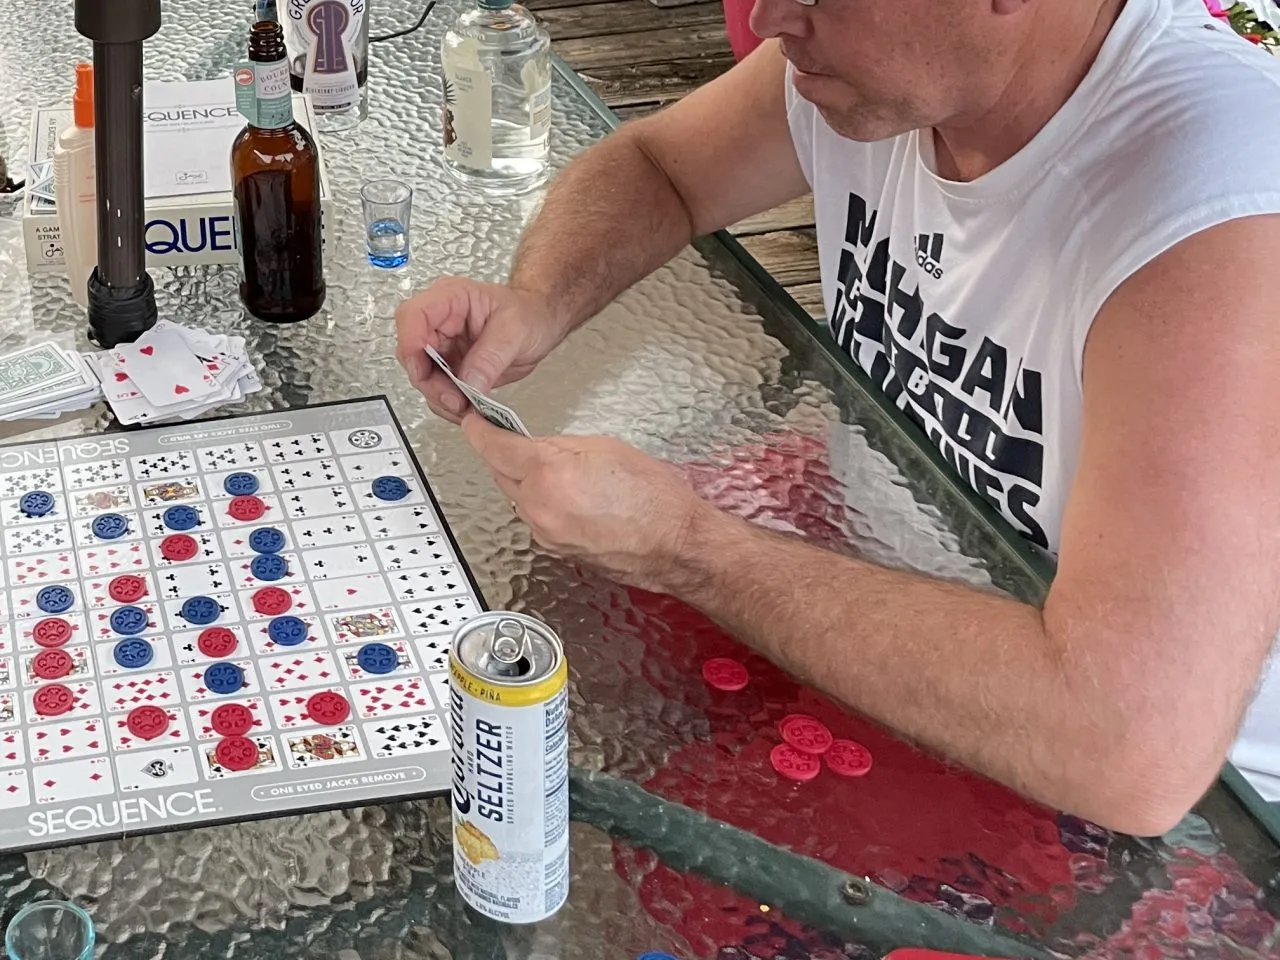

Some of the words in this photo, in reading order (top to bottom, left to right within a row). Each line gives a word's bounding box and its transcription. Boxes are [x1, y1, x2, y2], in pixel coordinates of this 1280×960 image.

[144, 107, 239, 122] QUENCE
[918, 254, 944, 280] das
[844, 191, 1043, 435] MCHGAN
[480, 688, 502, 702] PIÑA
[270, 786, 294, 796] ONE
[296, 782, 322, 794] EYED
[325, 777, 359, 790] JACKS
[361, 771, 407, 784] REMOVE
[476, 718, 504, 822] SELTZER
[505, 754, 514, 797] SPARKLING
[27, 788, 215, 838] SEQUENCE
